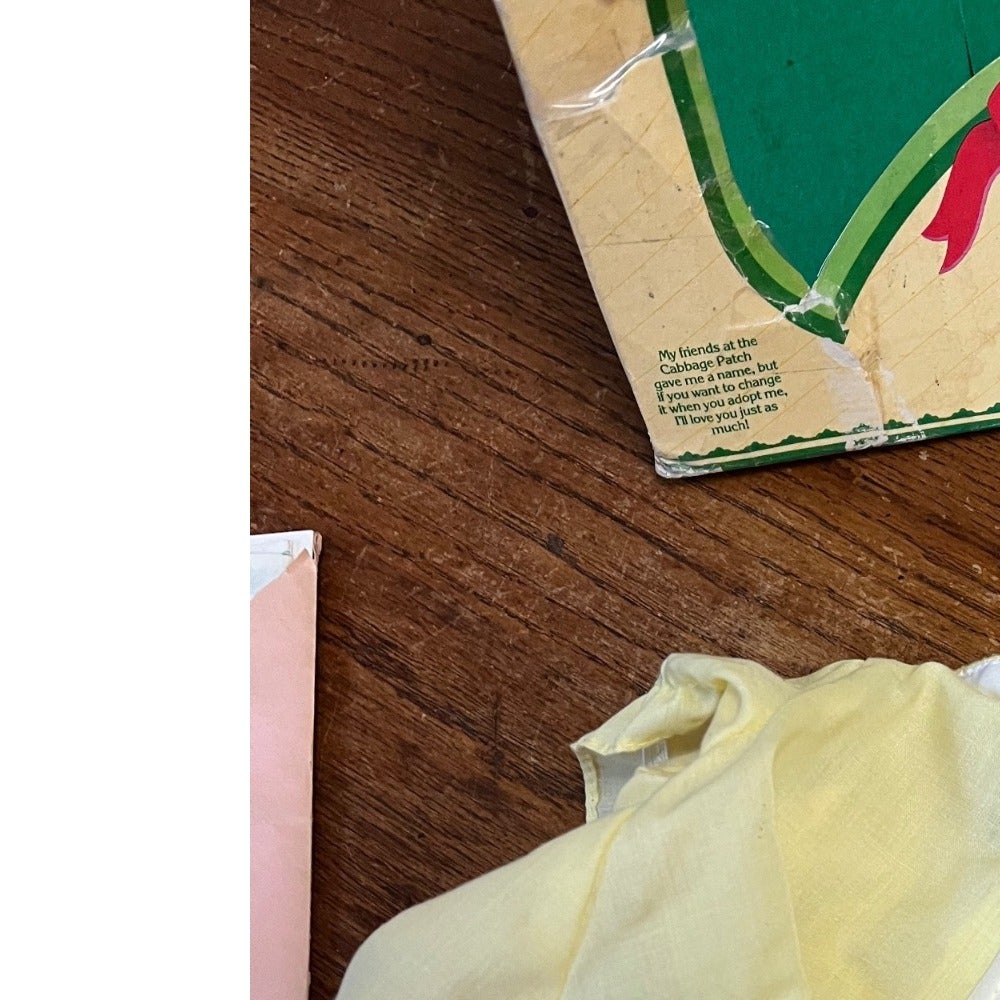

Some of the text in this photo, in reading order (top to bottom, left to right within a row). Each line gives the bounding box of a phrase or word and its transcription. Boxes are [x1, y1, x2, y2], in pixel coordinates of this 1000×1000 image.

[658, 337, 757, 362] My friends at the
[654, 360, 778, 391] gave me a name, but
[660, 352, 752, 374] Cabbage Patch
[656, 375, 781, 403] if you want to change
[658, 388, 787, 415] it when you adopt me,
[690, 413, 713, 423] love
[715, 410, 737, 422] you
[739, 404, 762, 418] just
[764, 403, 779, 411] as
[711, 419, 750, 435] much!
